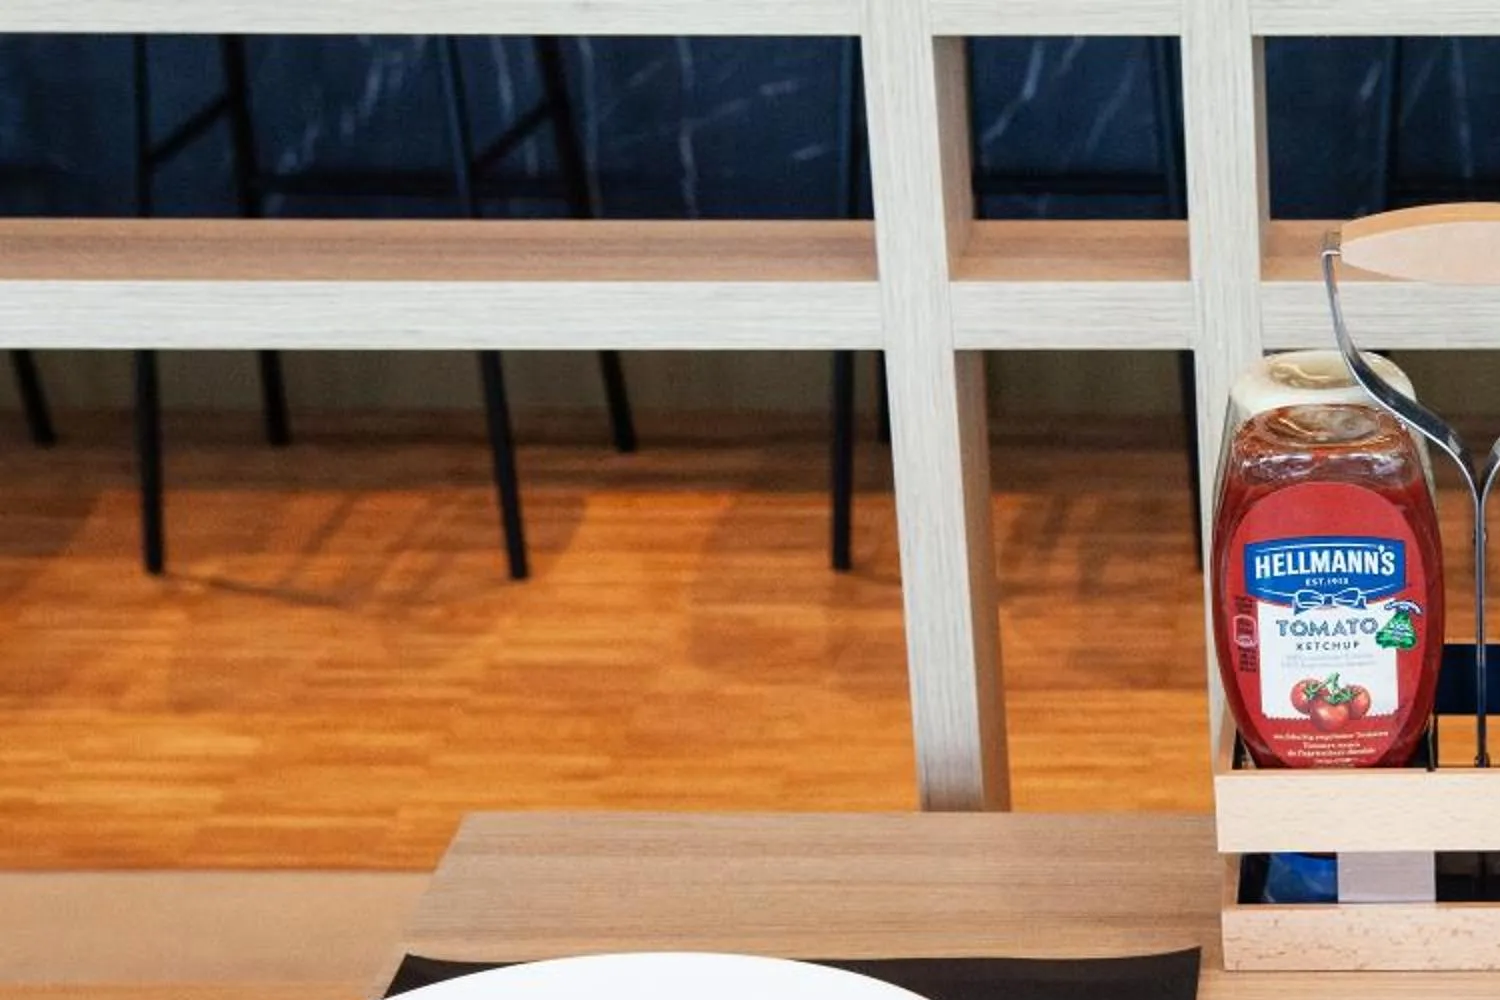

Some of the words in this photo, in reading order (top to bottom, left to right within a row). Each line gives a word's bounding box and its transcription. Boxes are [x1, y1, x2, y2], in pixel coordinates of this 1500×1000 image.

[1255, 544, 1396, 579] HELLMANN'S
[1275, 617, 1379, 637] TOMATO
[1295, 641, 1360, 651] KETCHUP
